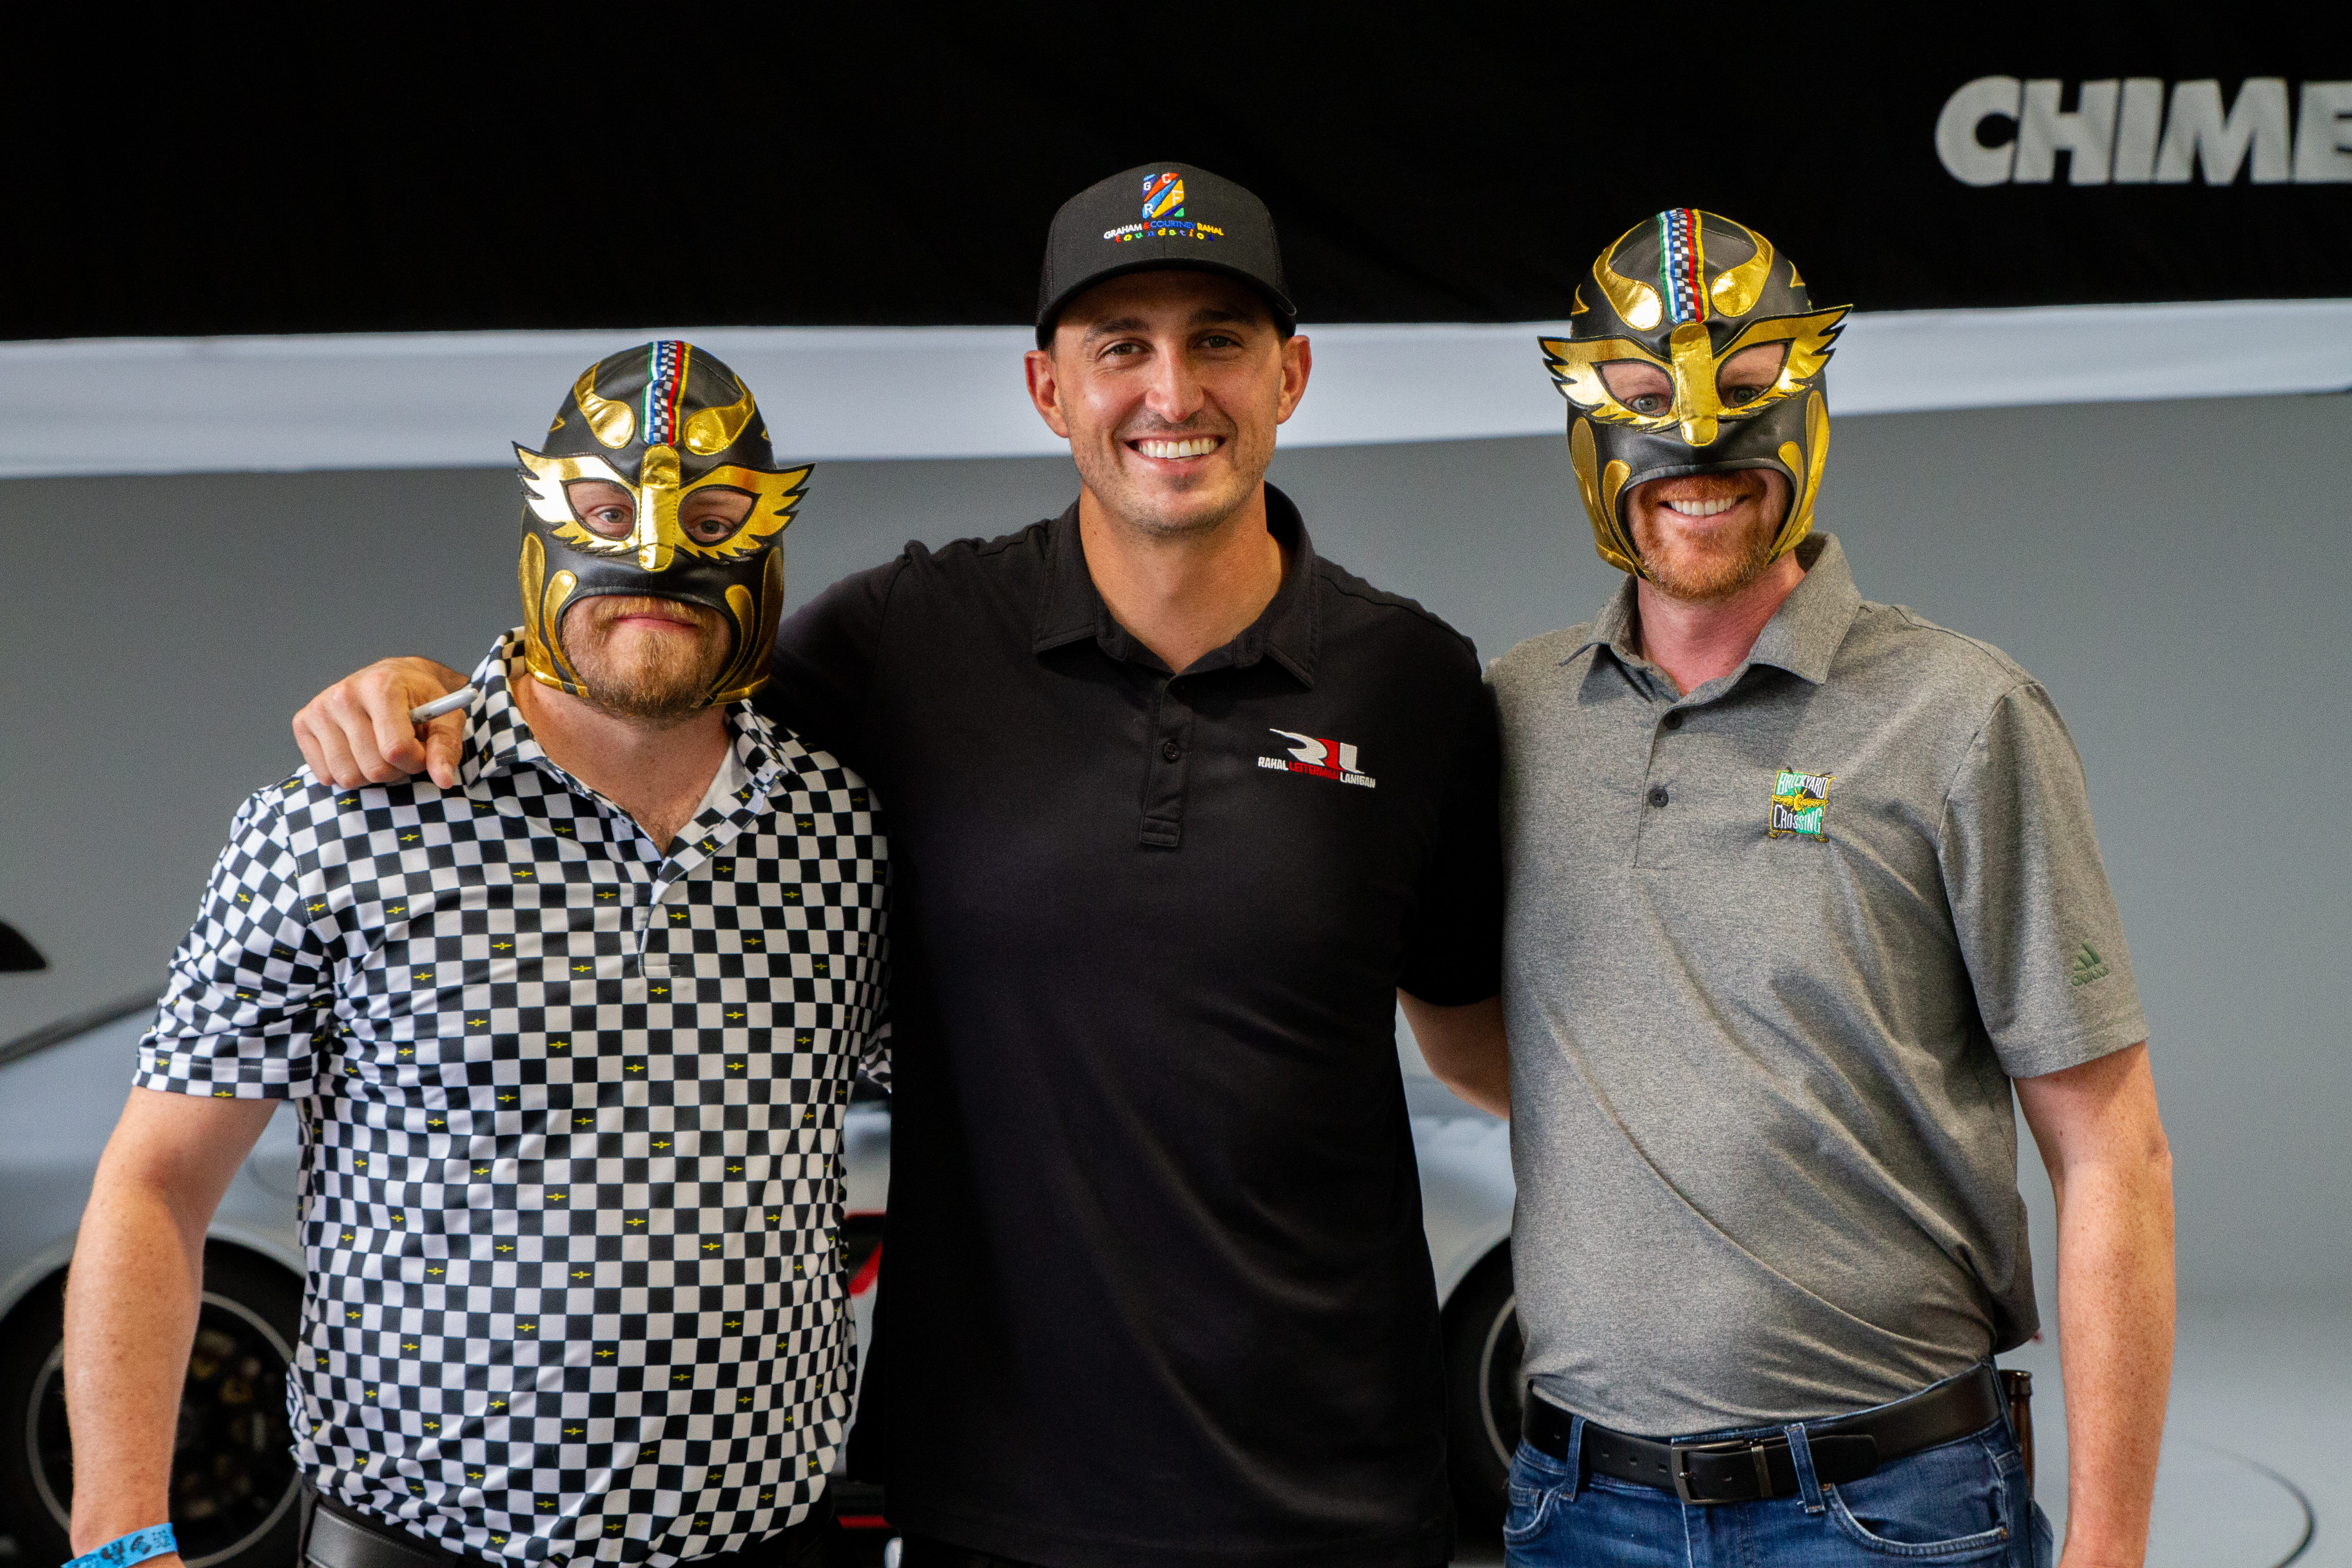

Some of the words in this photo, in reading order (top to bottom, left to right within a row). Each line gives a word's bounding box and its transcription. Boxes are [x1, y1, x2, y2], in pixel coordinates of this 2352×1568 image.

[1103, 223, 1142, 239] GRAHAM
[1150, 220, 1195, 229] COURTNEY
[1197, 222, 1224, 235] RAHAL
[1258, 756, 1289, 771] RAHAL
[1289, 761, 1338, 780] LETTERMAN
[1340, 771, 1376, 789] LANIGAN
[1777, 772, 1829, 799] BRICKYARD
